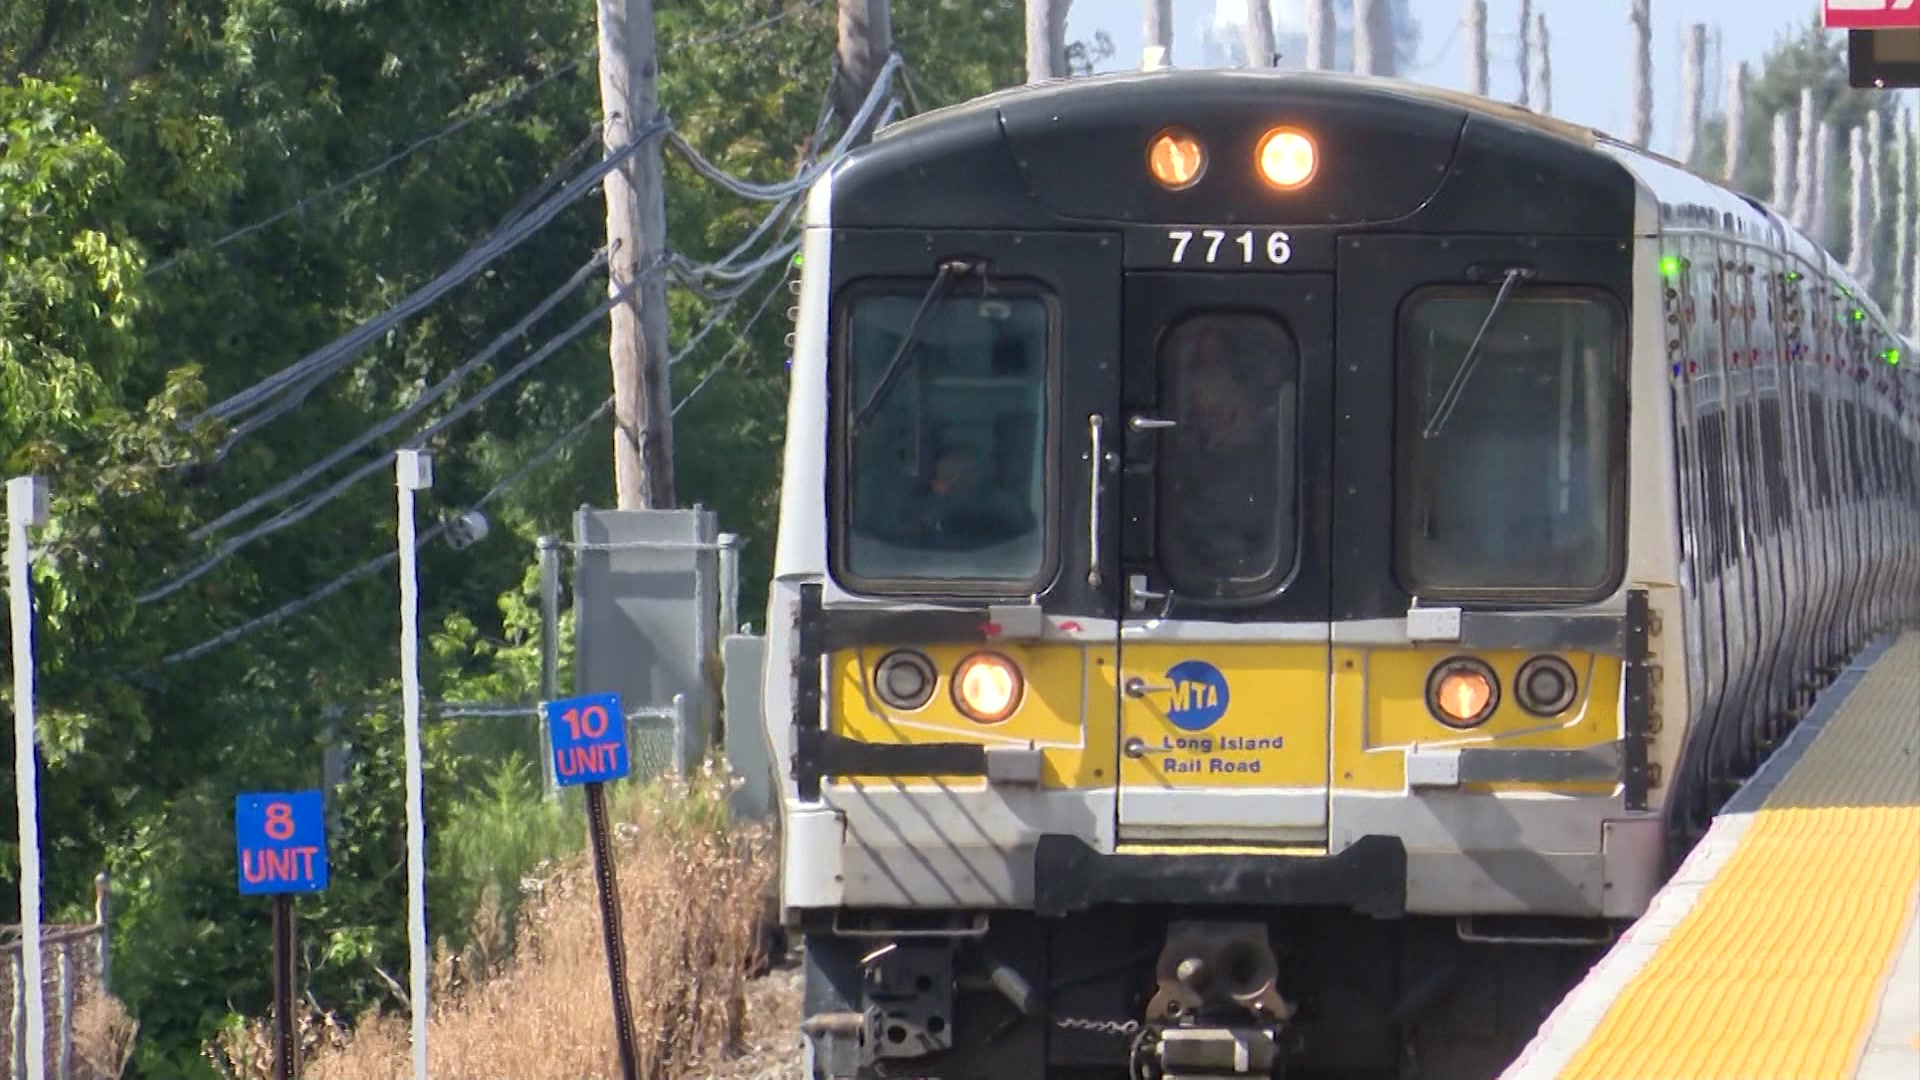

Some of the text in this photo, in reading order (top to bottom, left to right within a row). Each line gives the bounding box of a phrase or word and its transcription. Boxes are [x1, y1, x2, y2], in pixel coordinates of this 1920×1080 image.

[1168, 230, 1291, 265] 7716
[1168, 679, 1219, 712] MTA
[561, 704, 609, 740] 10
[557, 741, 622, 777] UNIT
[1163, 736, 1283, 753] Long Island
[1163, 758, 1261, 773] Rail Road
[264, 801, 295, 840] 8
[242, 846, 319, 884] UNIT
